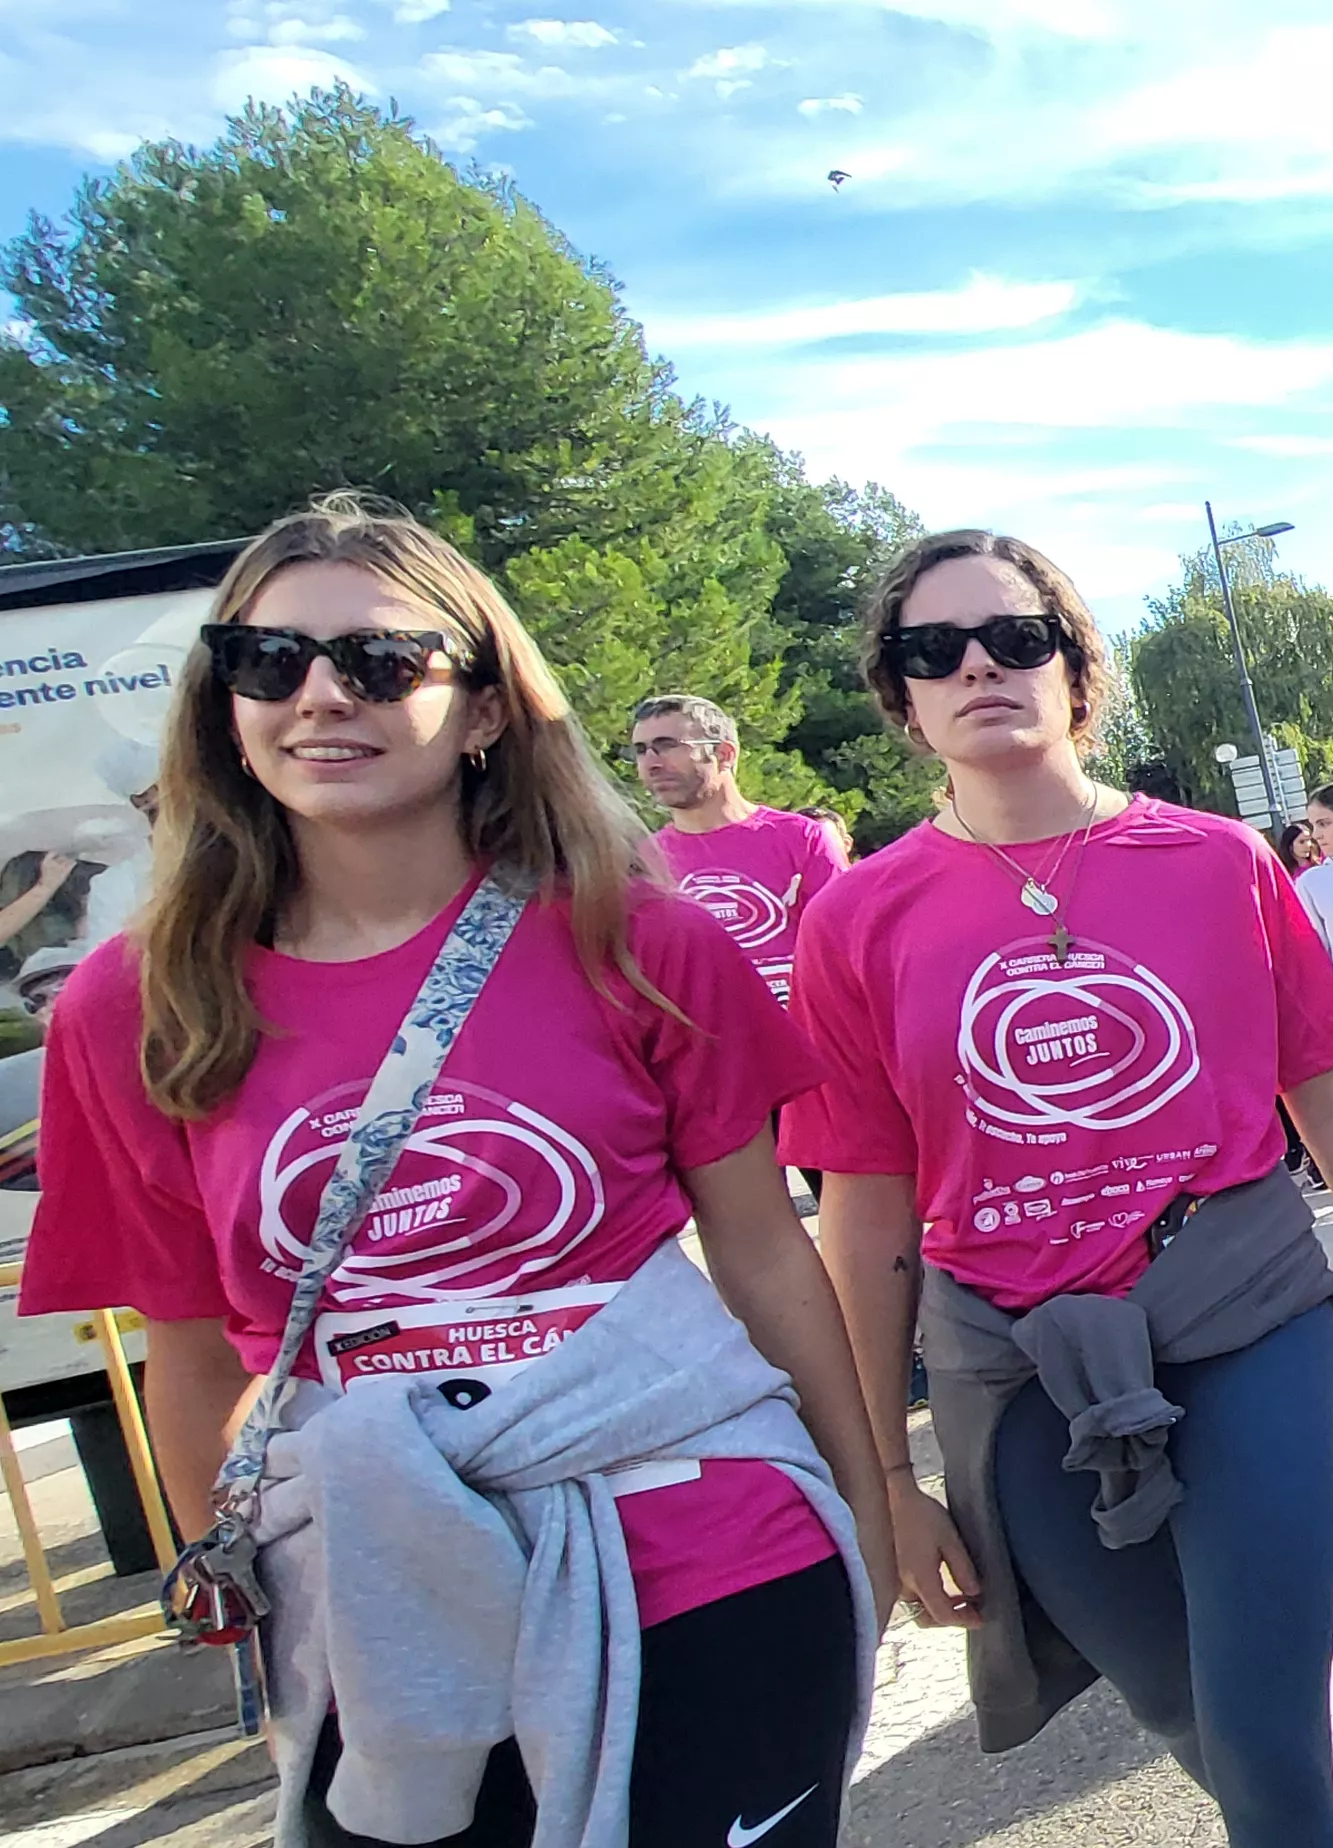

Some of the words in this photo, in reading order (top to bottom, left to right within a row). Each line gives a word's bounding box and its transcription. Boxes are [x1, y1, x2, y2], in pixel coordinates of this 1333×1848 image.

[85, 664, 172, 697] nivel
[1014, 1015, 1099, 1045] Caminemos
[1026, 1032, 1098, 1065] JUNTOS
[368, 1174, 461, 1213] minemos
[367, 1196, 453, 1242] JUNTOS
[448, 1319, 538, 1344] HUESCA
[353, 1345, 474, 1372] CONTRA
[480, 1341, 516, 1363] EL
